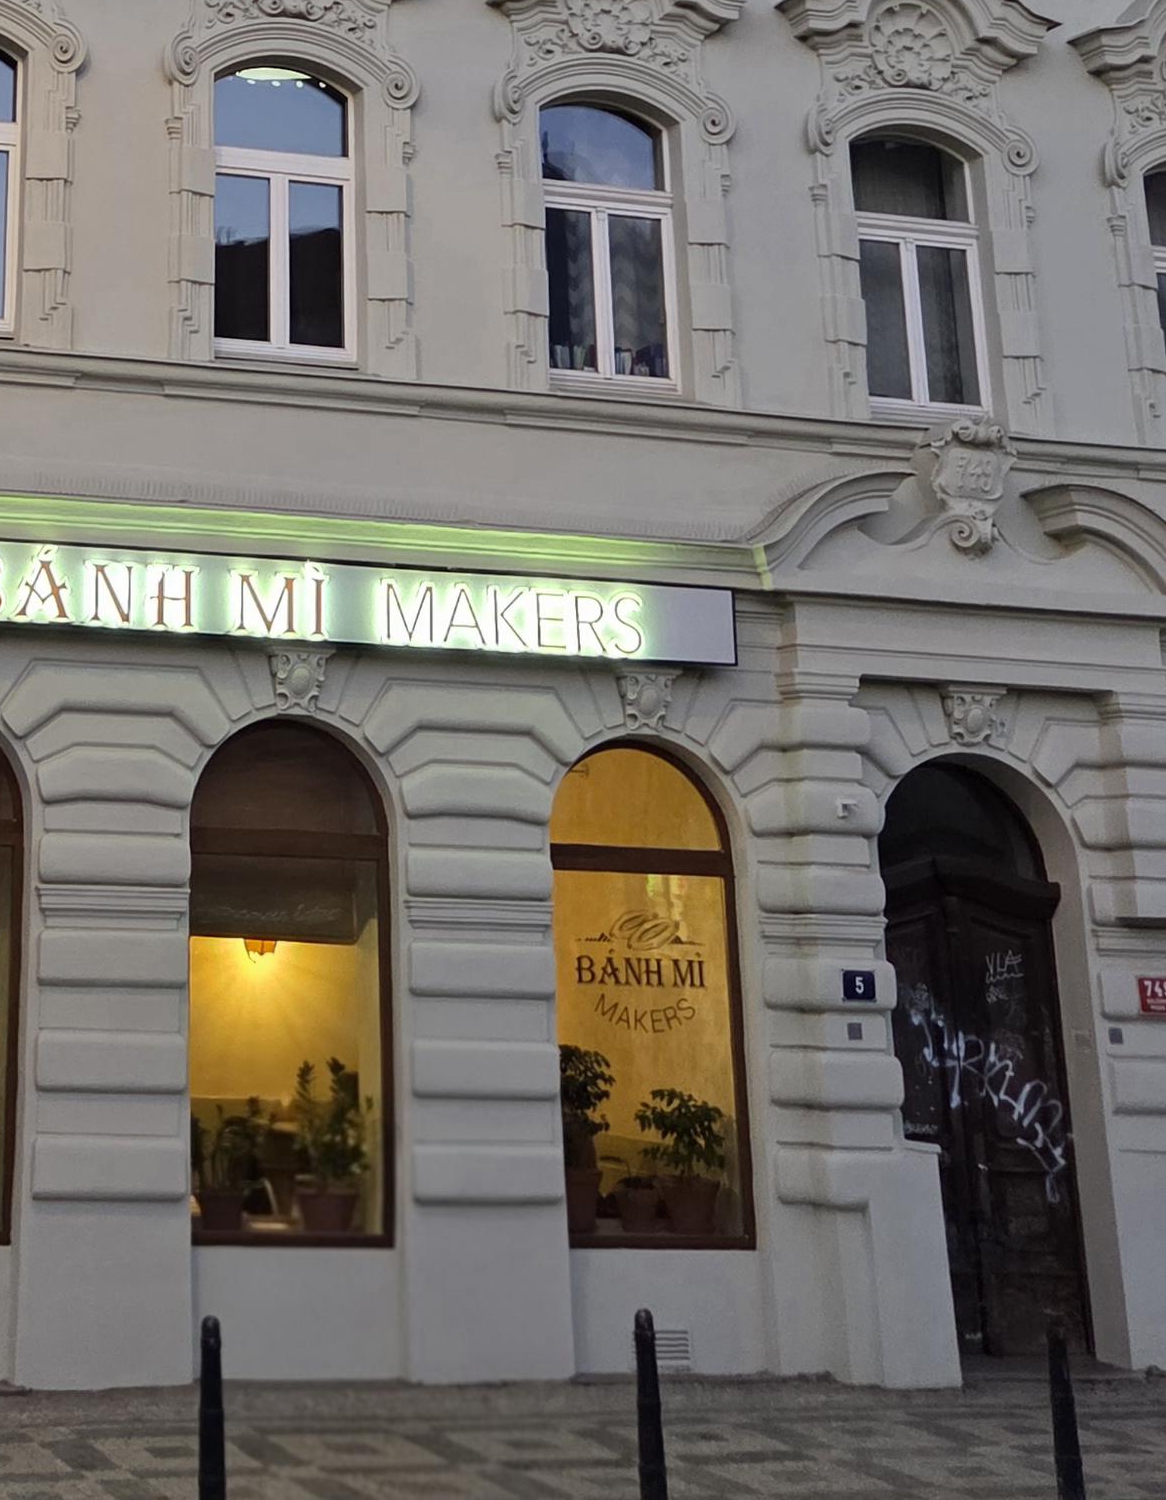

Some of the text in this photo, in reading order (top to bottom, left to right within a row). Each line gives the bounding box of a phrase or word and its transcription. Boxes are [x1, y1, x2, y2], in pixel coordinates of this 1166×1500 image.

[384, 582, 645, 656] MAKERS
[855, 975, 865, 994] 5
[594, 992, 697, 1034] MAKERS
